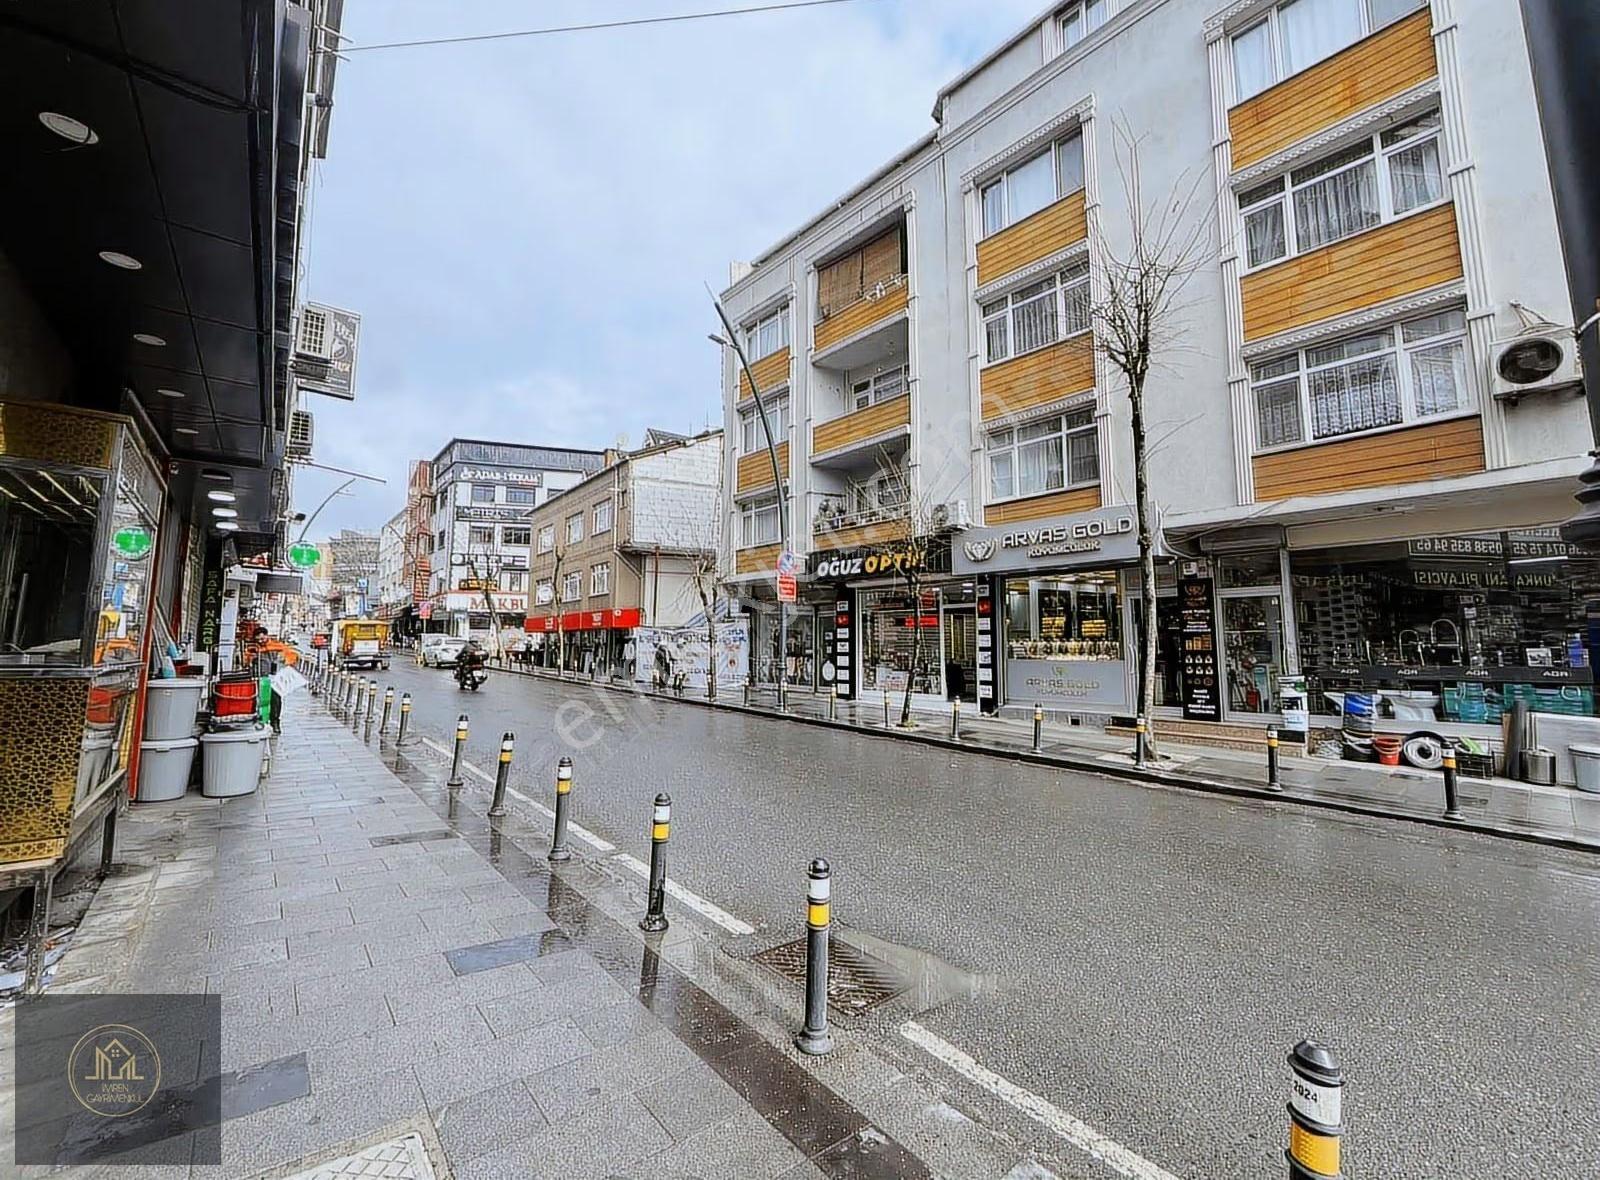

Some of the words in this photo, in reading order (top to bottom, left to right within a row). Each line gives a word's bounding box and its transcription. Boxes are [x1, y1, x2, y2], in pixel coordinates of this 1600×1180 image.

[1001, 525, 1067, 549] ARVAS
[1072, 515, 1133, 539] GOLD
[817, 556, 863, 577] OĞUZ
[470, 597, 528, 611] MKB
[1292, 1080, 1318, 1103] 2024
